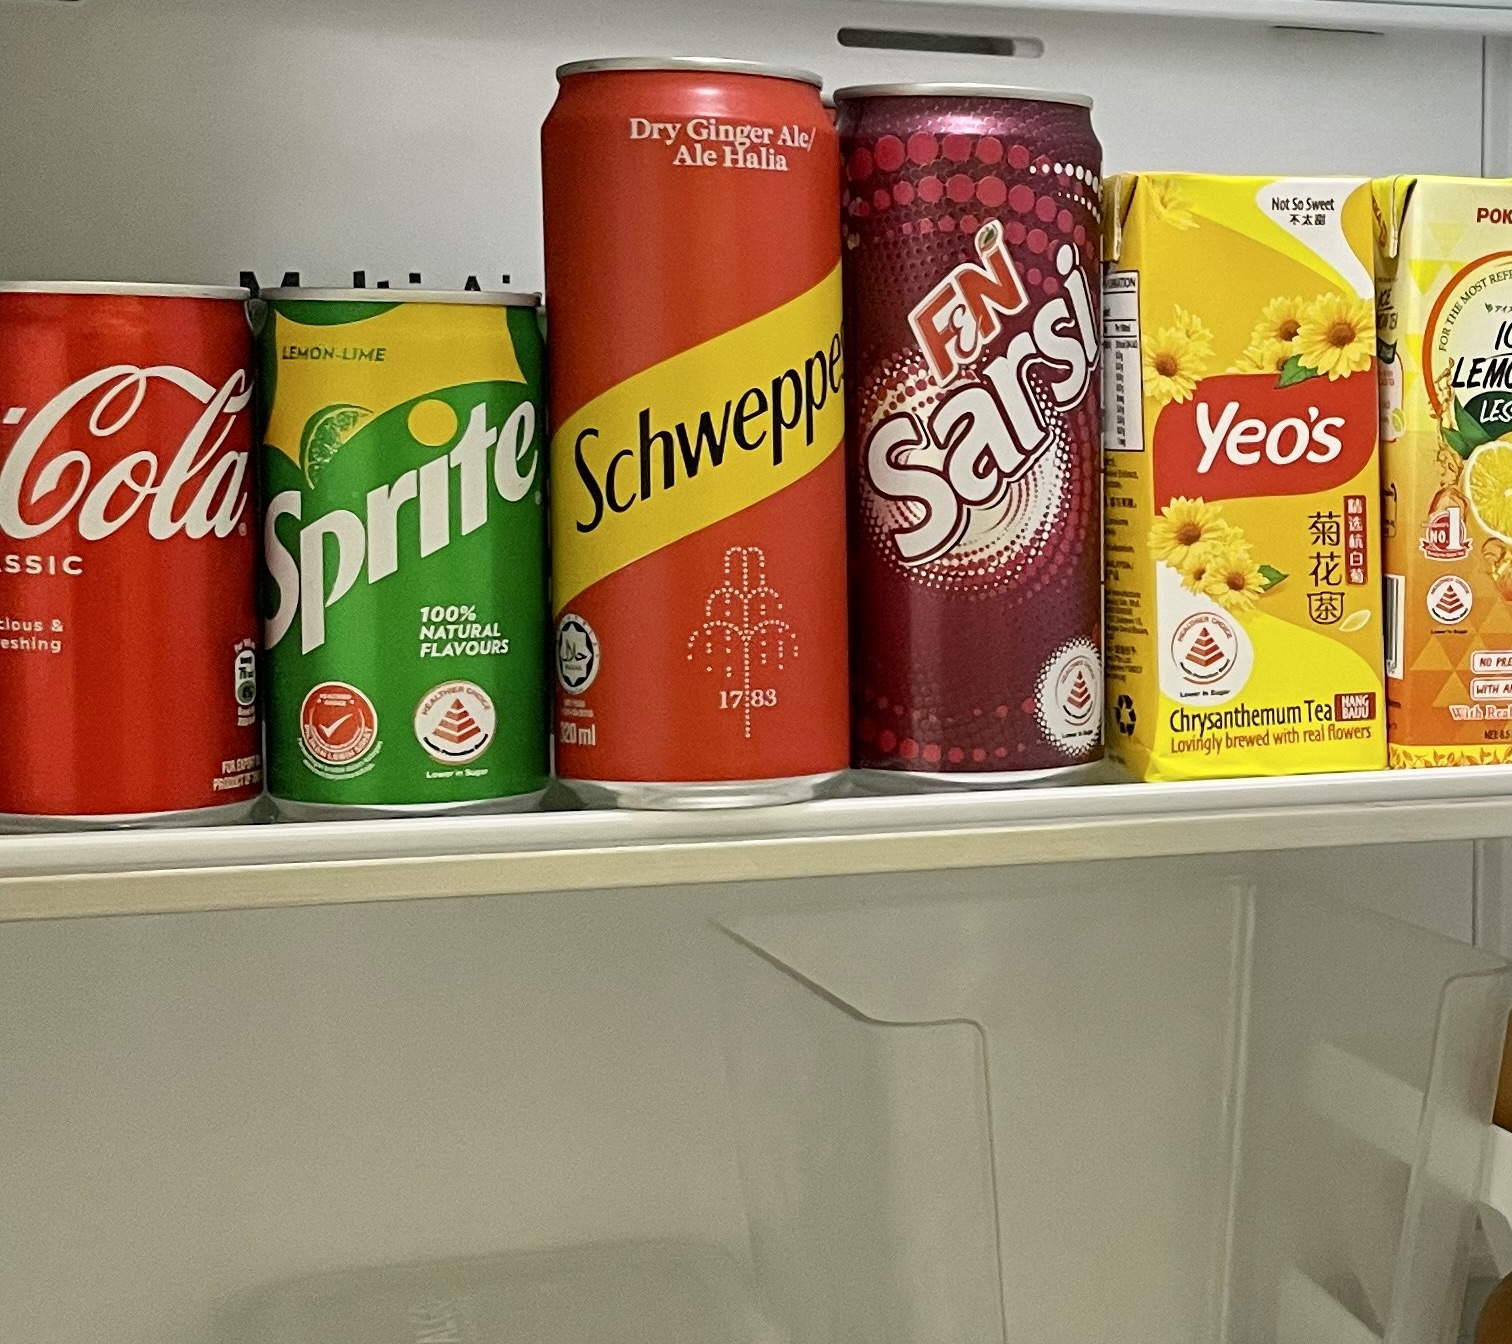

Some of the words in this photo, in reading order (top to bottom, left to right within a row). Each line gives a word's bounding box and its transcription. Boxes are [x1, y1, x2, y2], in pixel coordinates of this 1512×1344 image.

[630, 118, 681, 145] Dry
[686, 118, 773, 150] Ginger
[777, 125, 816, 152] Ale/
[673, 143, 717, 166] Ale
[723, 146, 788, 171] Halia
[1271, 197, 1290, 211] Not
[1292, 197, 1303, 211] So
[1306, 197, 1335, 211] Sweet
[1438, 328, 1451, 352] FOR
[1446, 302, 1464, 325] THE
[1460, 278, 1488, 304] MOST
[282, 346, 386, 362] LEMON-LIME
[868, 244, 1098, 559] Sarsi
[574, 320, 844, 533] Schweppe
[1196, 401, 1346, 474] Yeo's
[264, 400, 539, 655] Sprite
[0, 554, 83, 575] SSIC
[1307, 511, 1343, 622] 菊花茶
[51, 619, 64, 632] &
[420, 605, 477, 622] 100%
[419, 623, 501, 640] NATURAL
[420, 639, 509, 657] FLAVOURS
[1479, 658, 1492, 667] NO
[1476, 685, 1499, 694] WITH
[1169, 703, 1302, 737] Chrysanthemum
[1304, 699, 1332, 722] Tea
[1450, 705, 1483, 720] With
[1171, 736, 1222, 755] Lovingly
[1225, 729, 1270, 749] brewed
[1273, 725, 1300, 745] with
[1303, 724, 1325, 742] real
[1328, 723, 1371, 739] flowers
